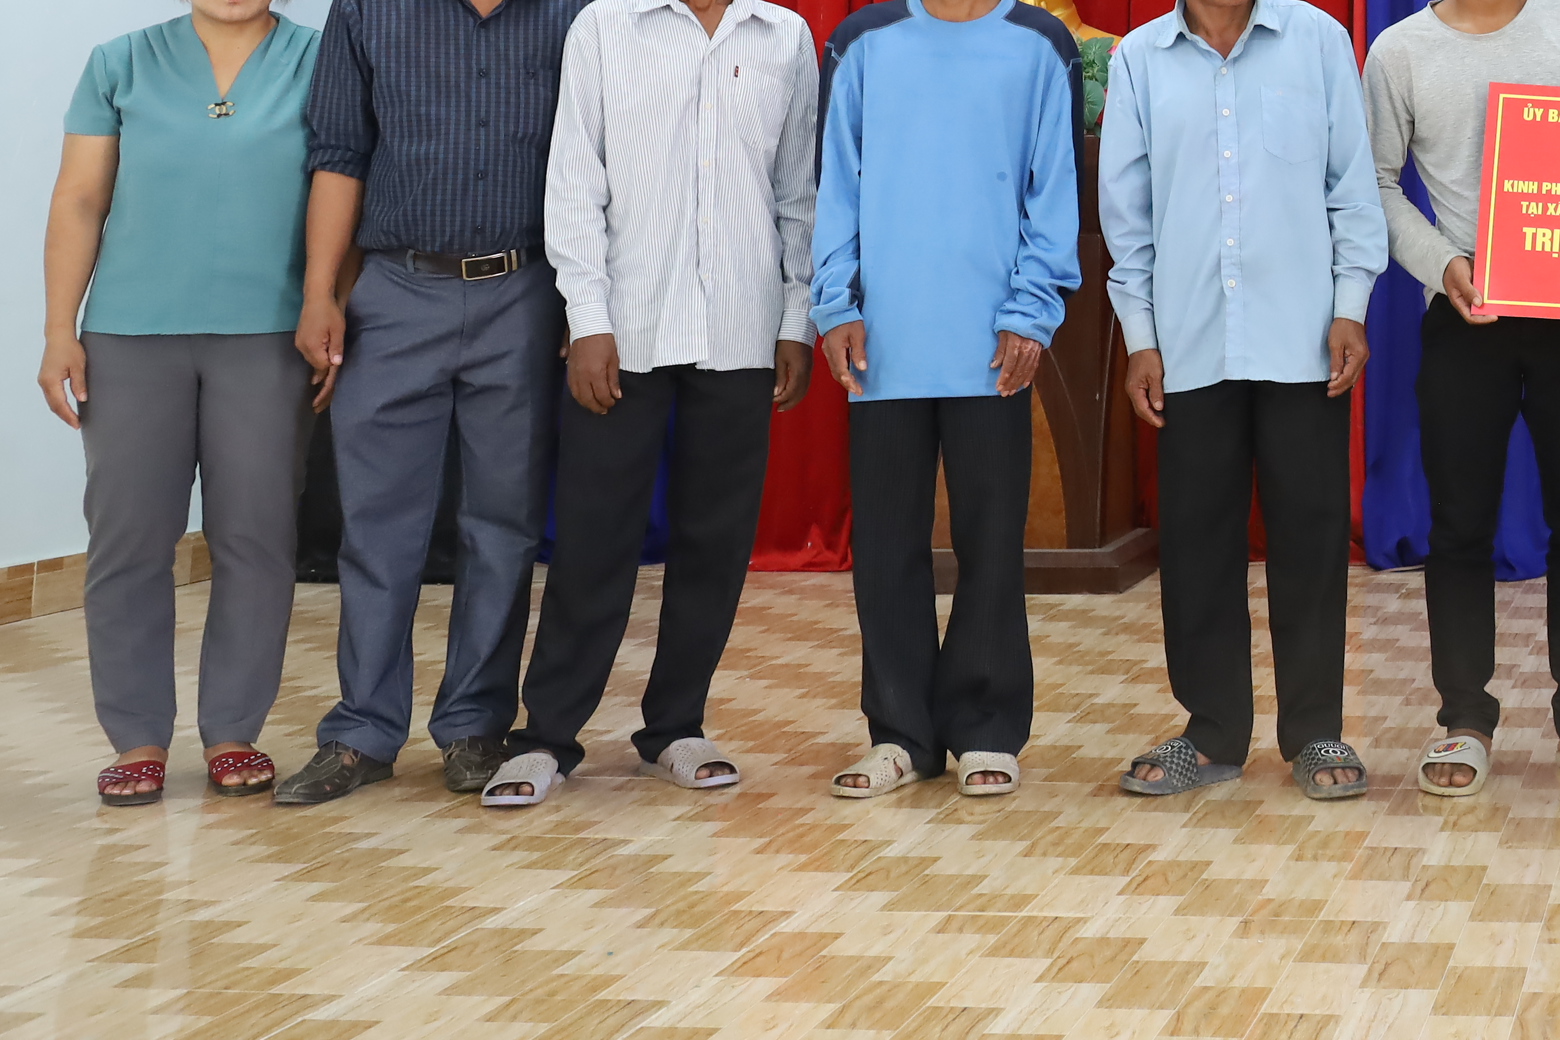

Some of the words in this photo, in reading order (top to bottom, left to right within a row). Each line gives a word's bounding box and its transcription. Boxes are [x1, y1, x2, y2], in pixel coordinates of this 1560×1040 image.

[1522, 102, 1545, 122] ỦY
[1503, 179, 1539, 194] KINH
[1520, 201, 1544, 218] TẠI
[1522, 226, 1560, 259] TRỊ
